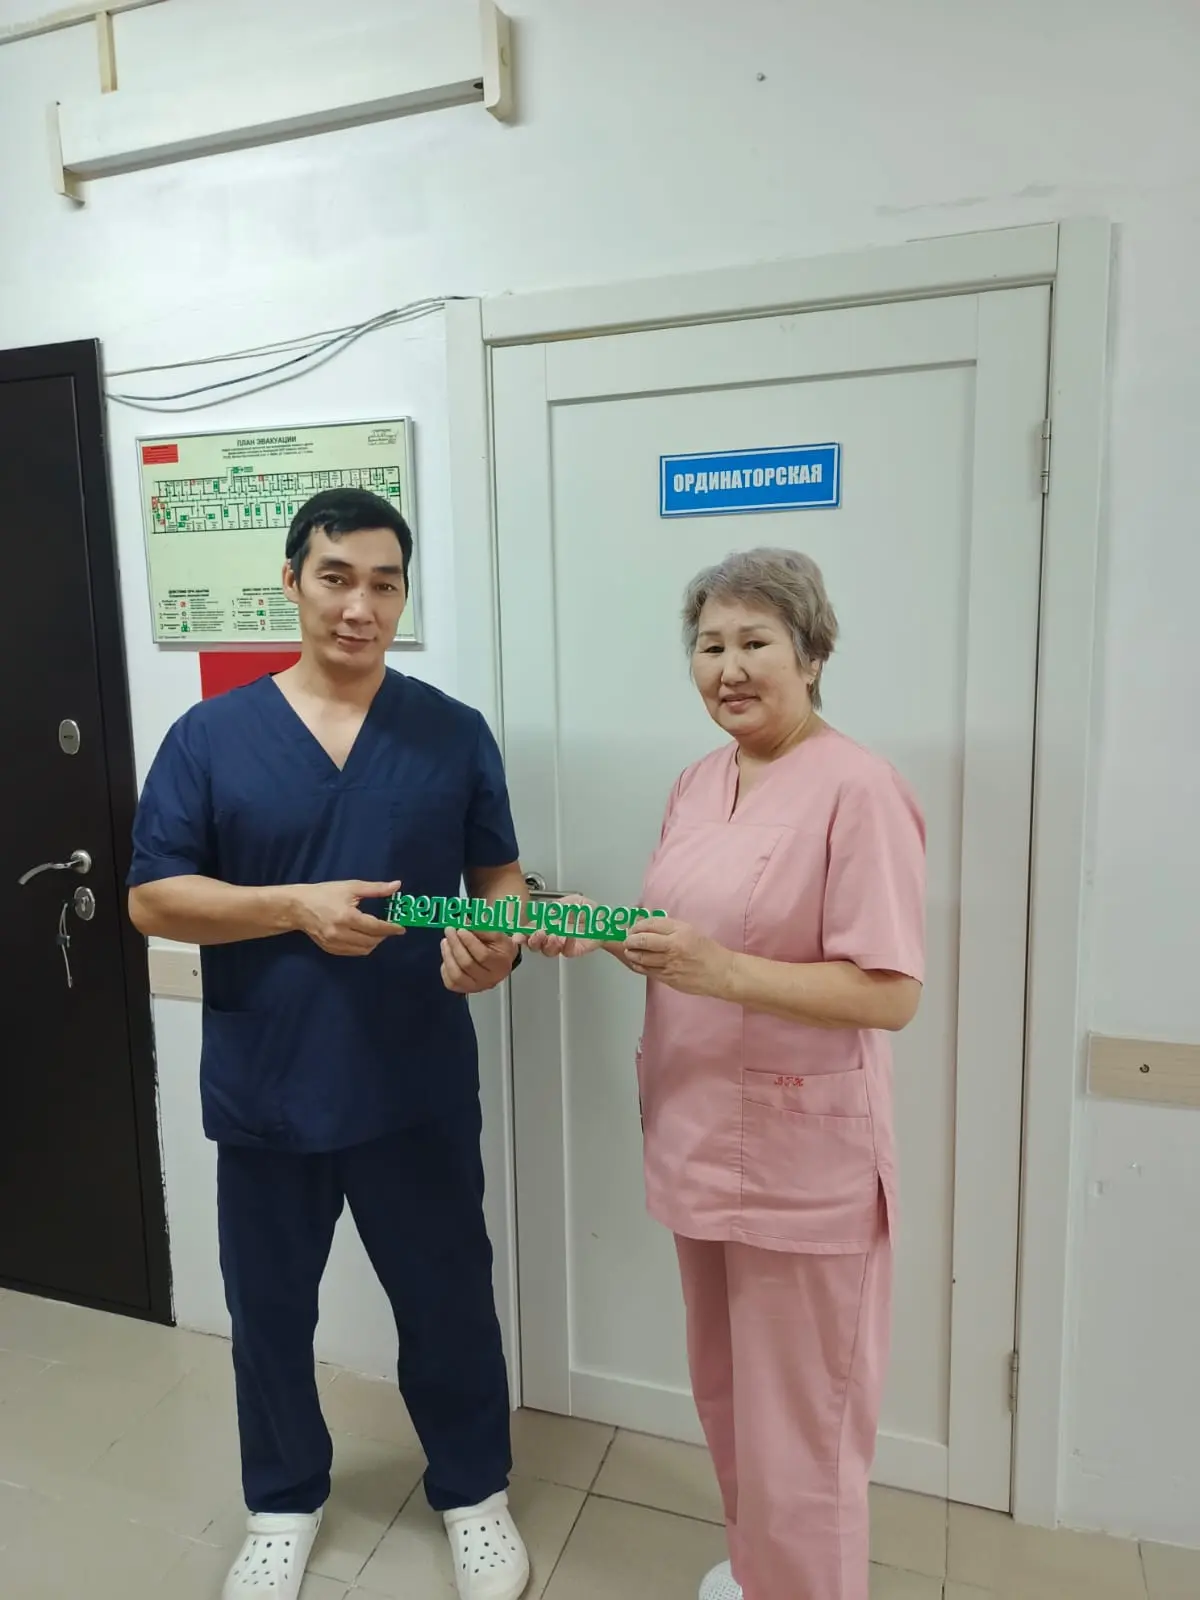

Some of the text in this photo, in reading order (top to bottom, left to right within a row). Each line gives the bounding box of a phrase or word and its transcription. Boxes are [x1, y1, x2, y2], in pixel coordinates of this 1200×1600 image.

[236, 439, 255, 447] ПЛАН
[256, 436, 297, 445] ЭВАКУАЦИИ
[673, 463, 823, 494] ОРДИНАТОРСКАЯ
[527, 901, 667, 937] четвер
